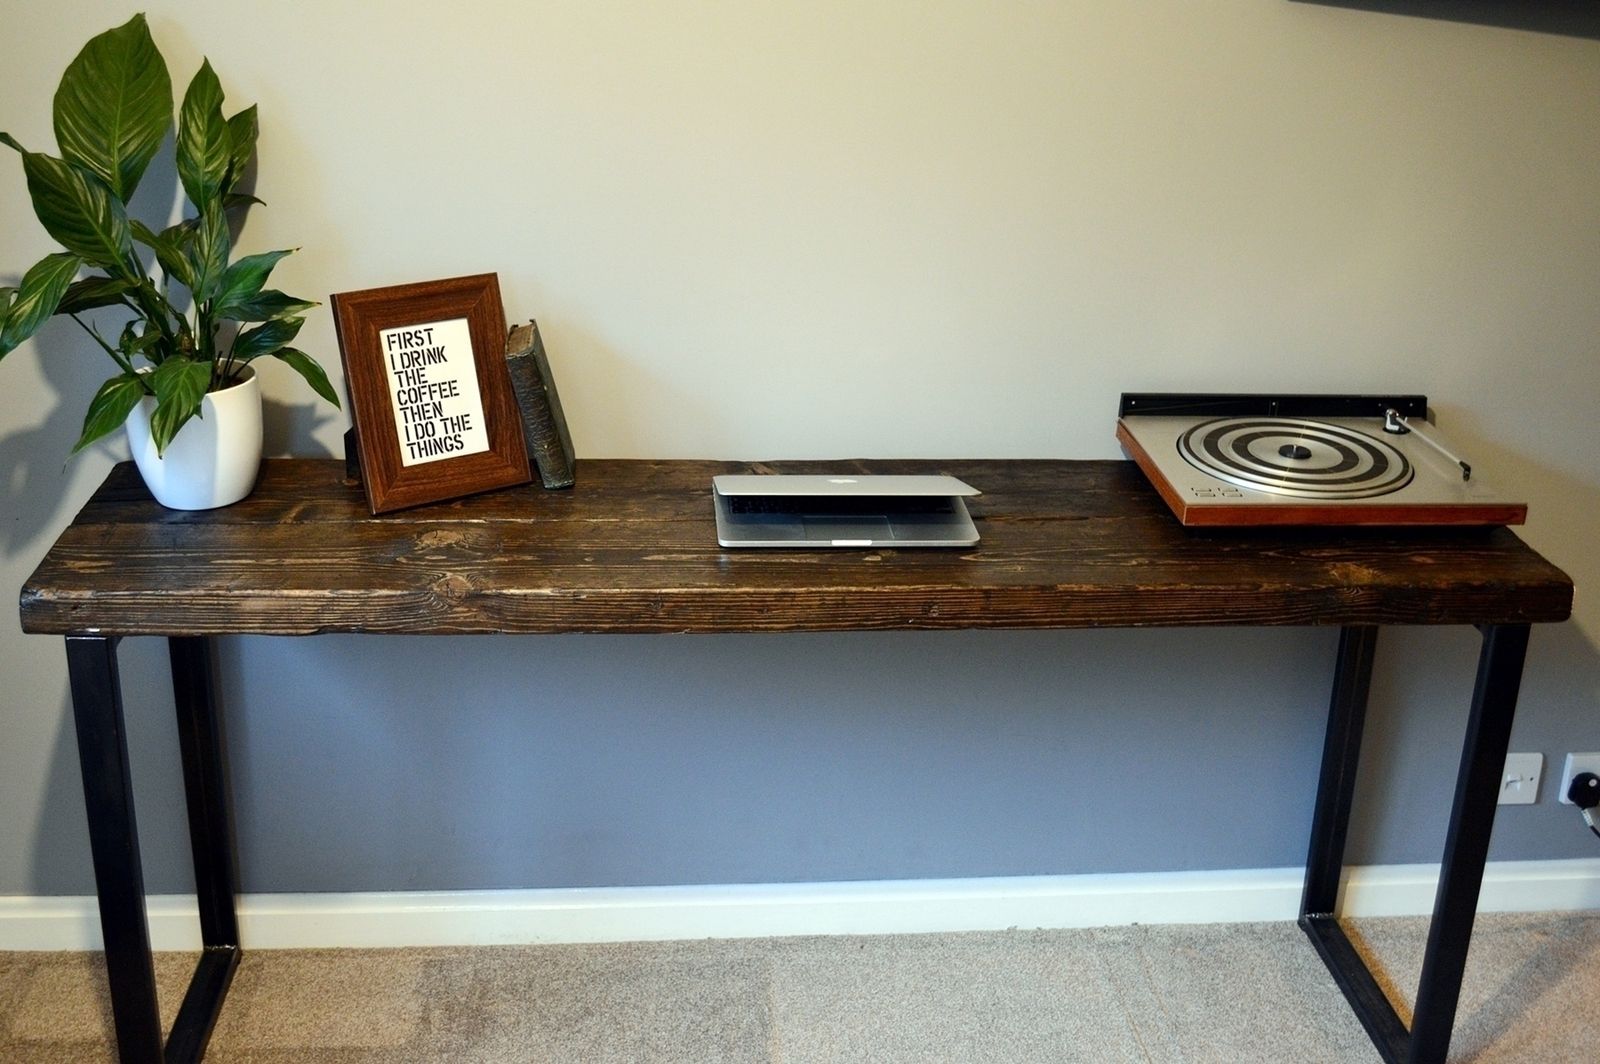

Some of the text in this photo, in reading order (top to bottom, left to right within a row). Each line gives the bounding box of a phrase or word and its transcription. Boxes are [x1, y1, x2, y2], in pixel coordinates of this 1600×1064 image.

[387, 328, 433, 351] FIRST
[390, 346, 448, 371] I DRINK
[394, 367, 428, 388] THE
[397, 380, 460, 406] COFFEE
[399, 401, 443, 424] THEN
[405, 414, 472, 442] I DO THE
[406, 434, 464, 459] THINGS
